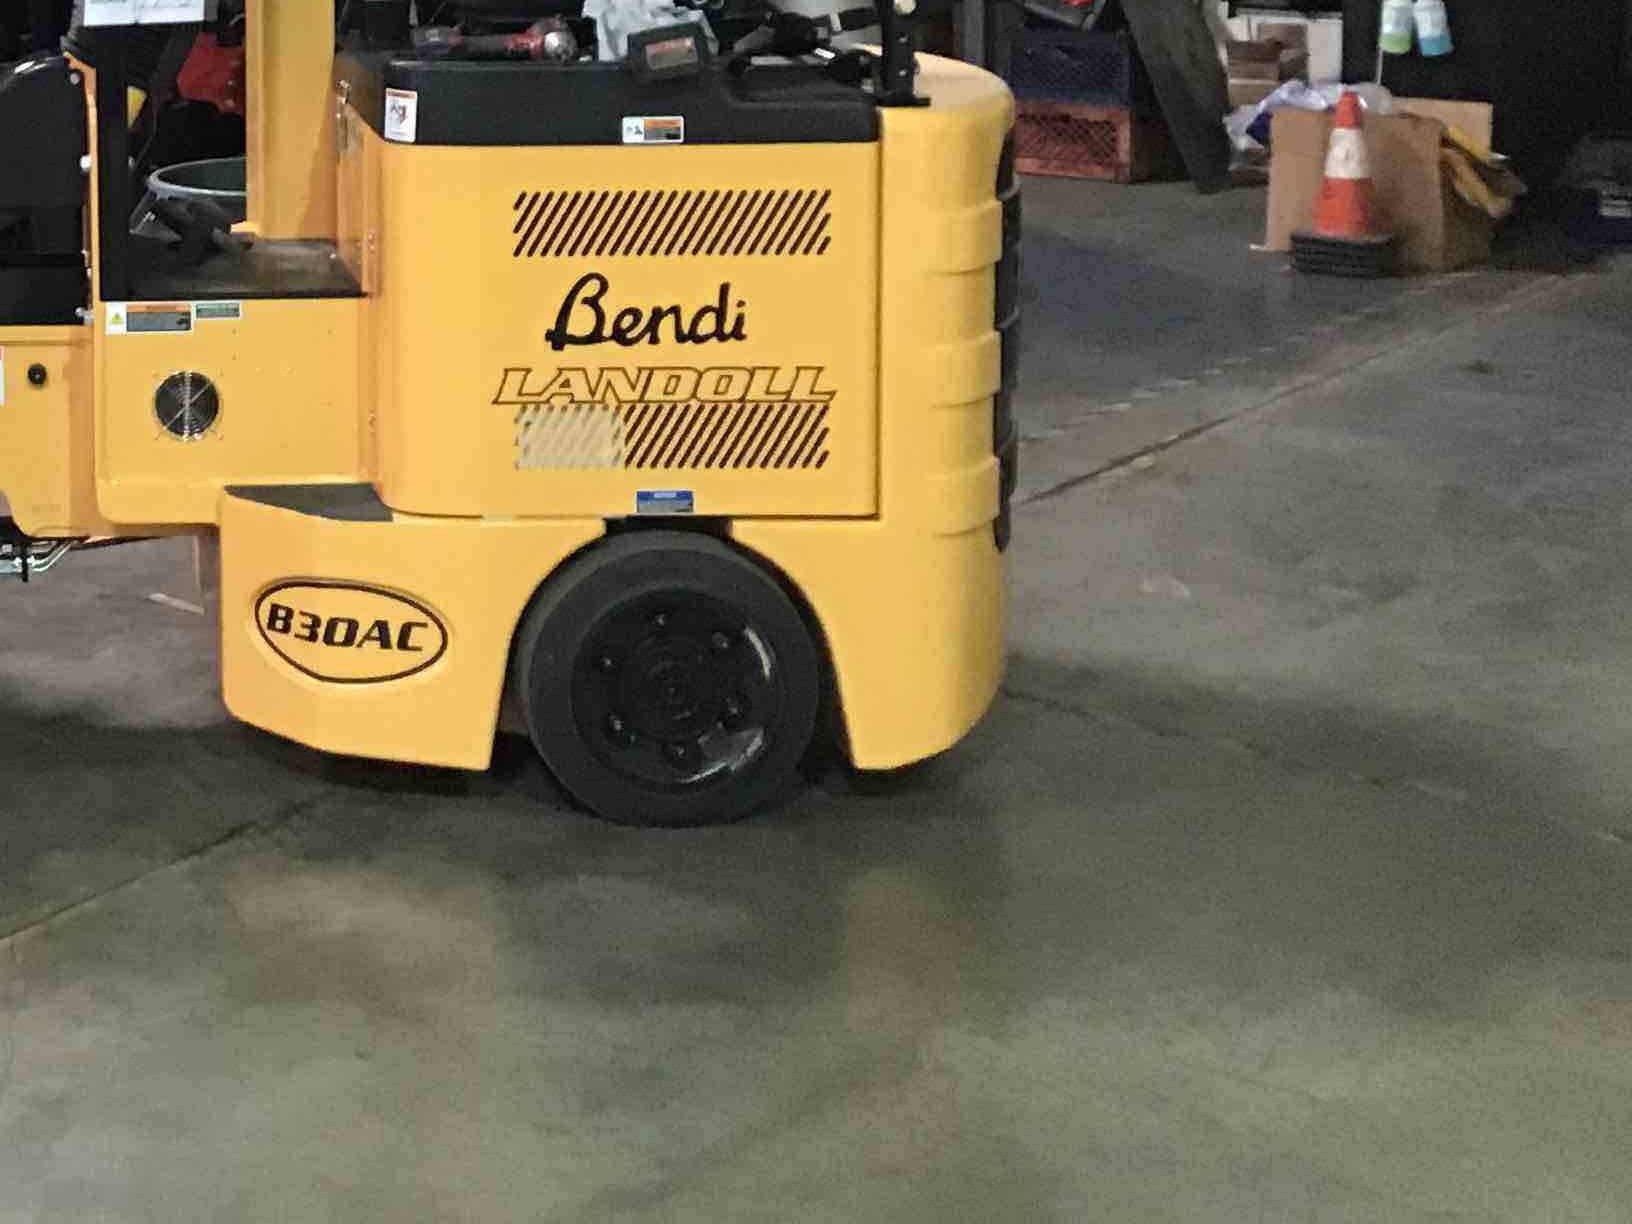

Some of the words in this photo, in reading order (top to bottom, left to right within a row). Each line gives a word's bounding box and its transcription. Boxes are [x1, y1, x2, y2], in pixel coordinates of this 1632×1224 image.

[545, 273, 747, 351] Bendi
[491, 366, 838, 404] LANDOLL
[266, 602, 429, 652] B30AC
